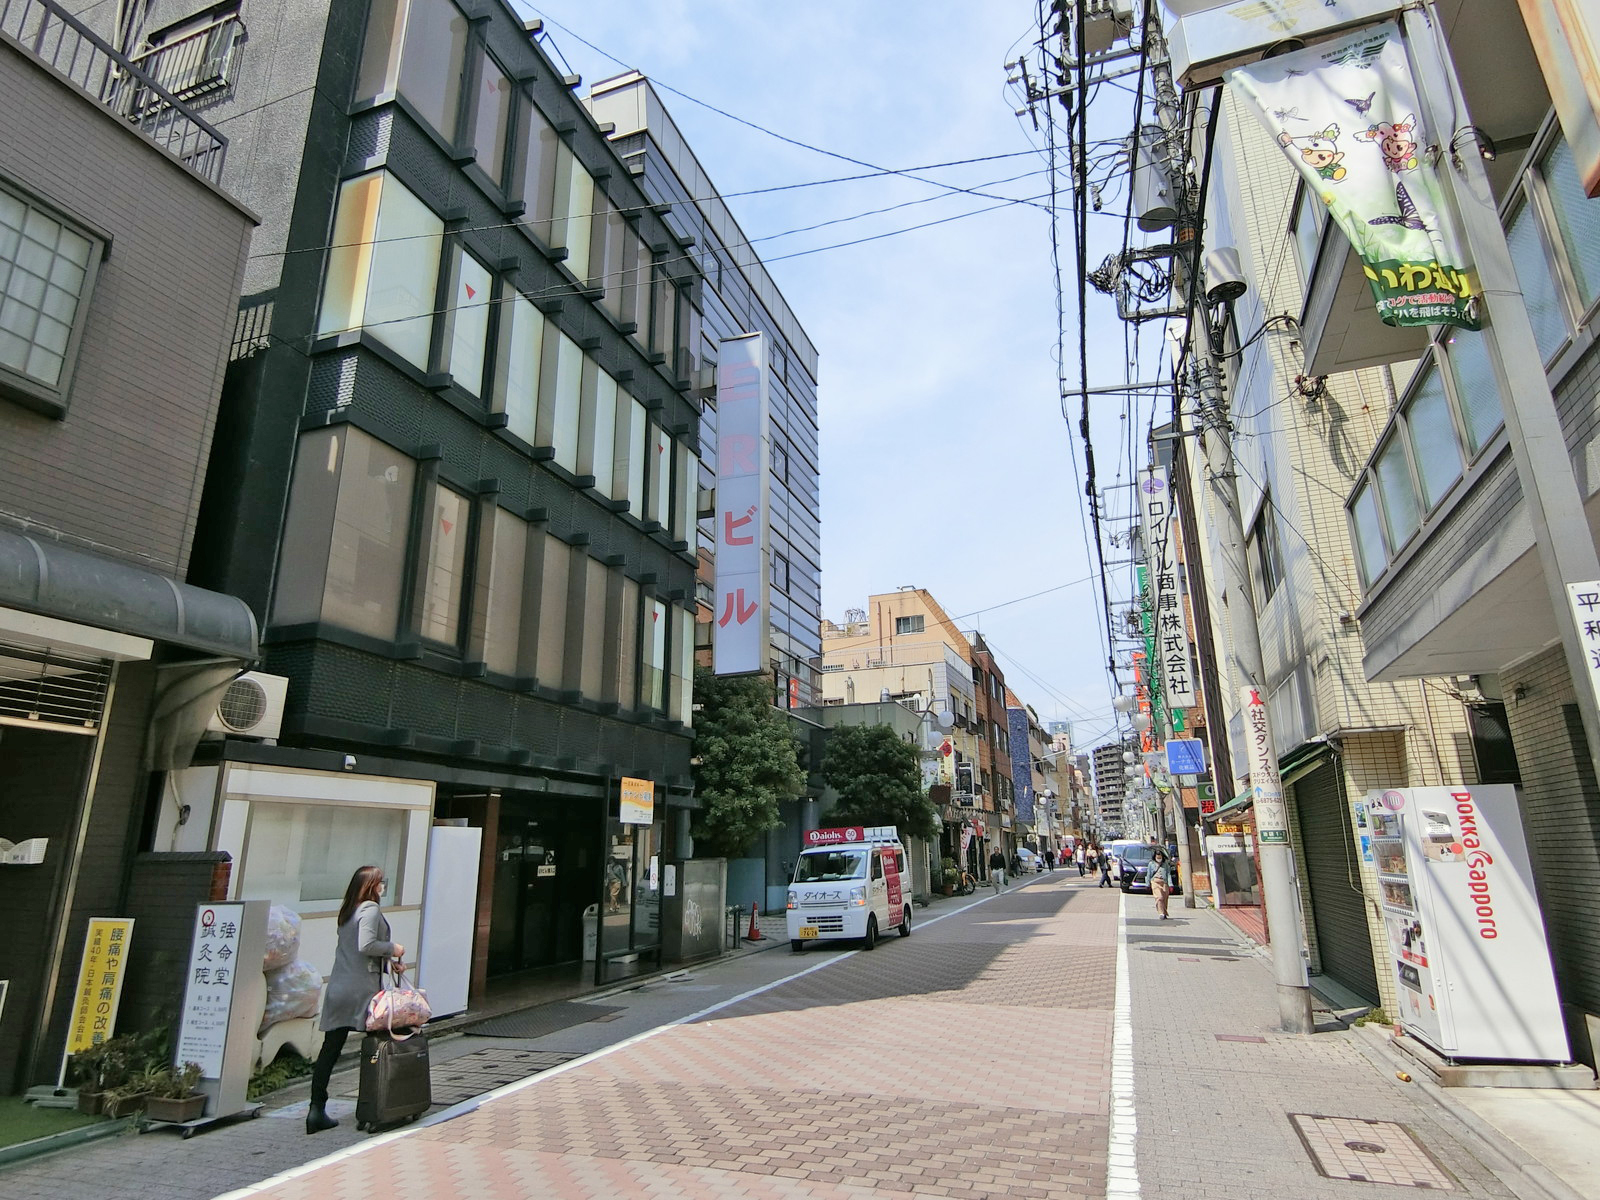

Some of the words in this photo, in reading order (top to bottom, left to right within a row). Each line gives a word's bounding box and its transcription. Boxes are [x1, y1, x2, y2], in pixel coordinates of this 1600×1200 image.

[1148, 501, 1190, 695] ロイヤル商事株式会社
[1250, 708, 1272, 771] 社交ダンス
[803, 890, 843, 901] ダイオーズ
[212, 921, 237, 985] 強命堂
[91, 927, 125, 1045] 腰痛や肩痛の改善
